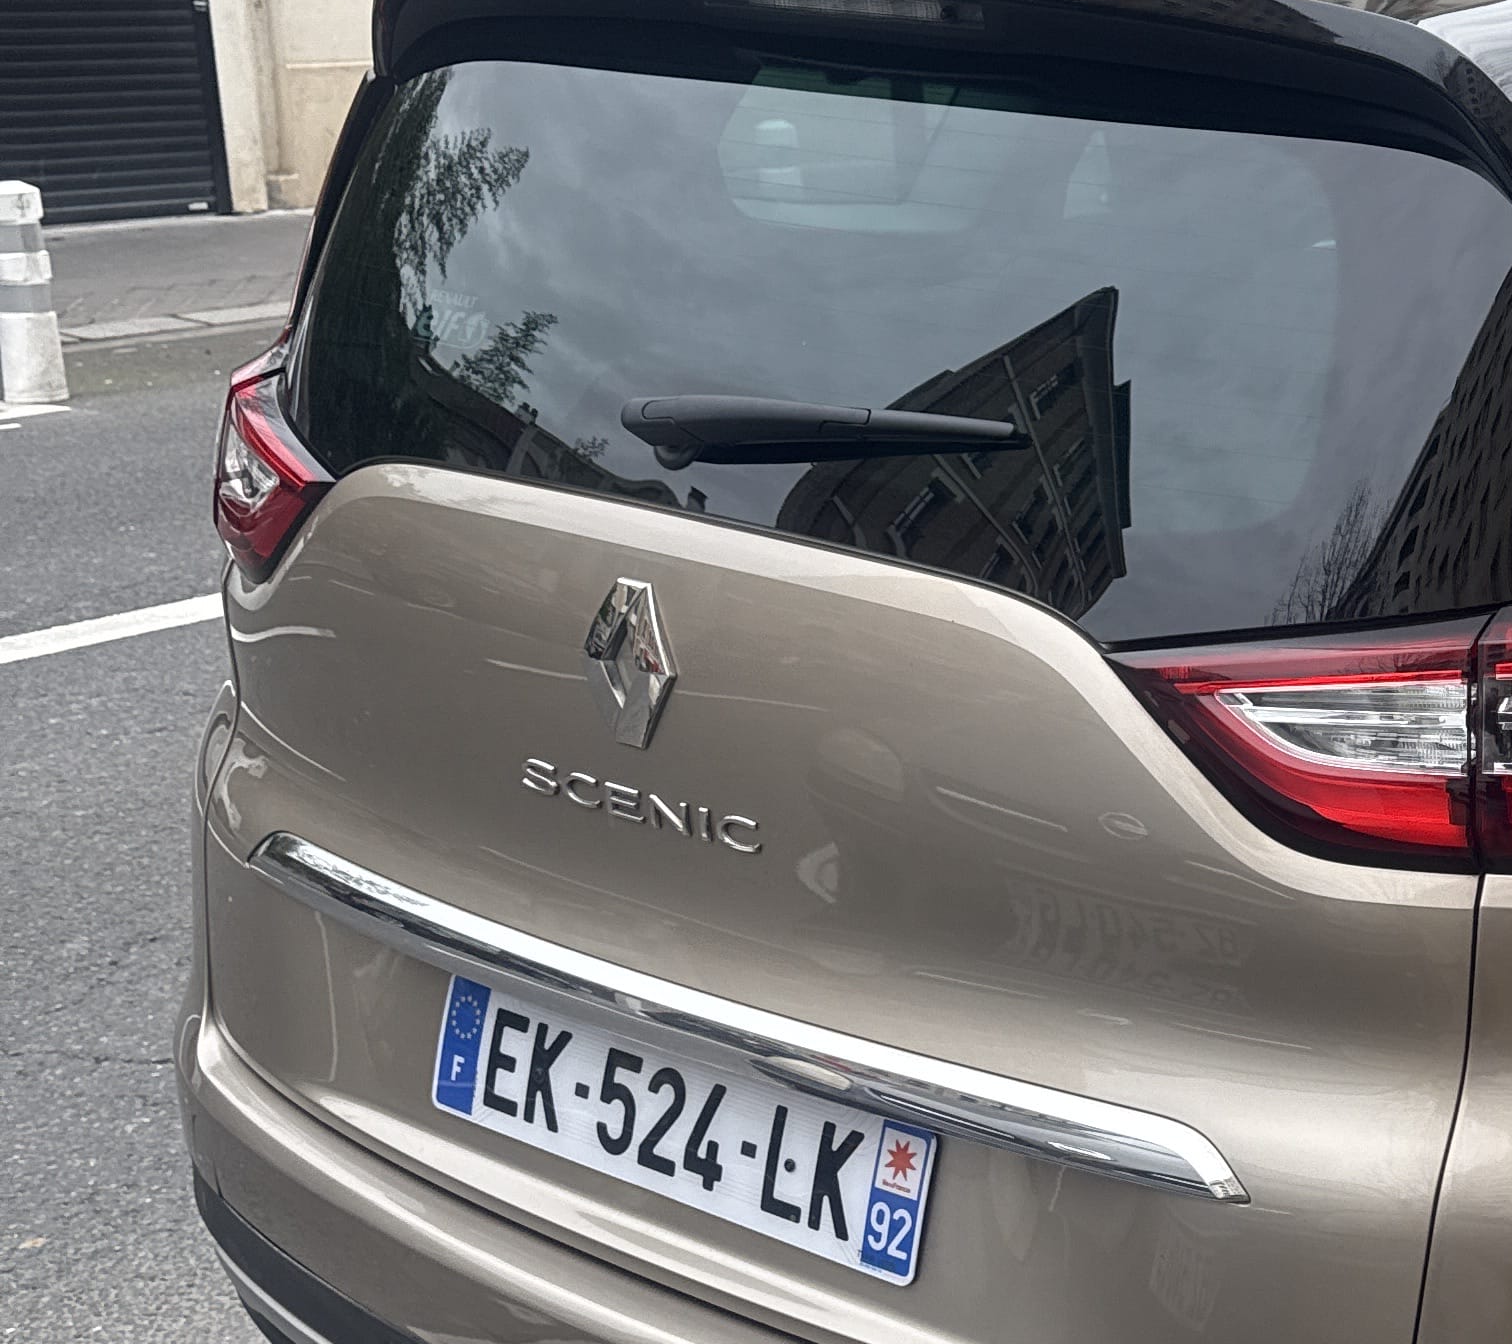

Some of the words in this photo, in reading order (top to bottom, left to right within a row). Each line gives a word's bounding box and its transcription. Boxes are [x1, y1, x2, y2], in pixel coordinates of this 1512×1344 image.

[521, 758, 763, 854] SCENIC
[451, 1054, 466, 1081] F
[483, 1008, 865, 1241] EK-524-LK
[867, 1201, 912, 1261] 92
